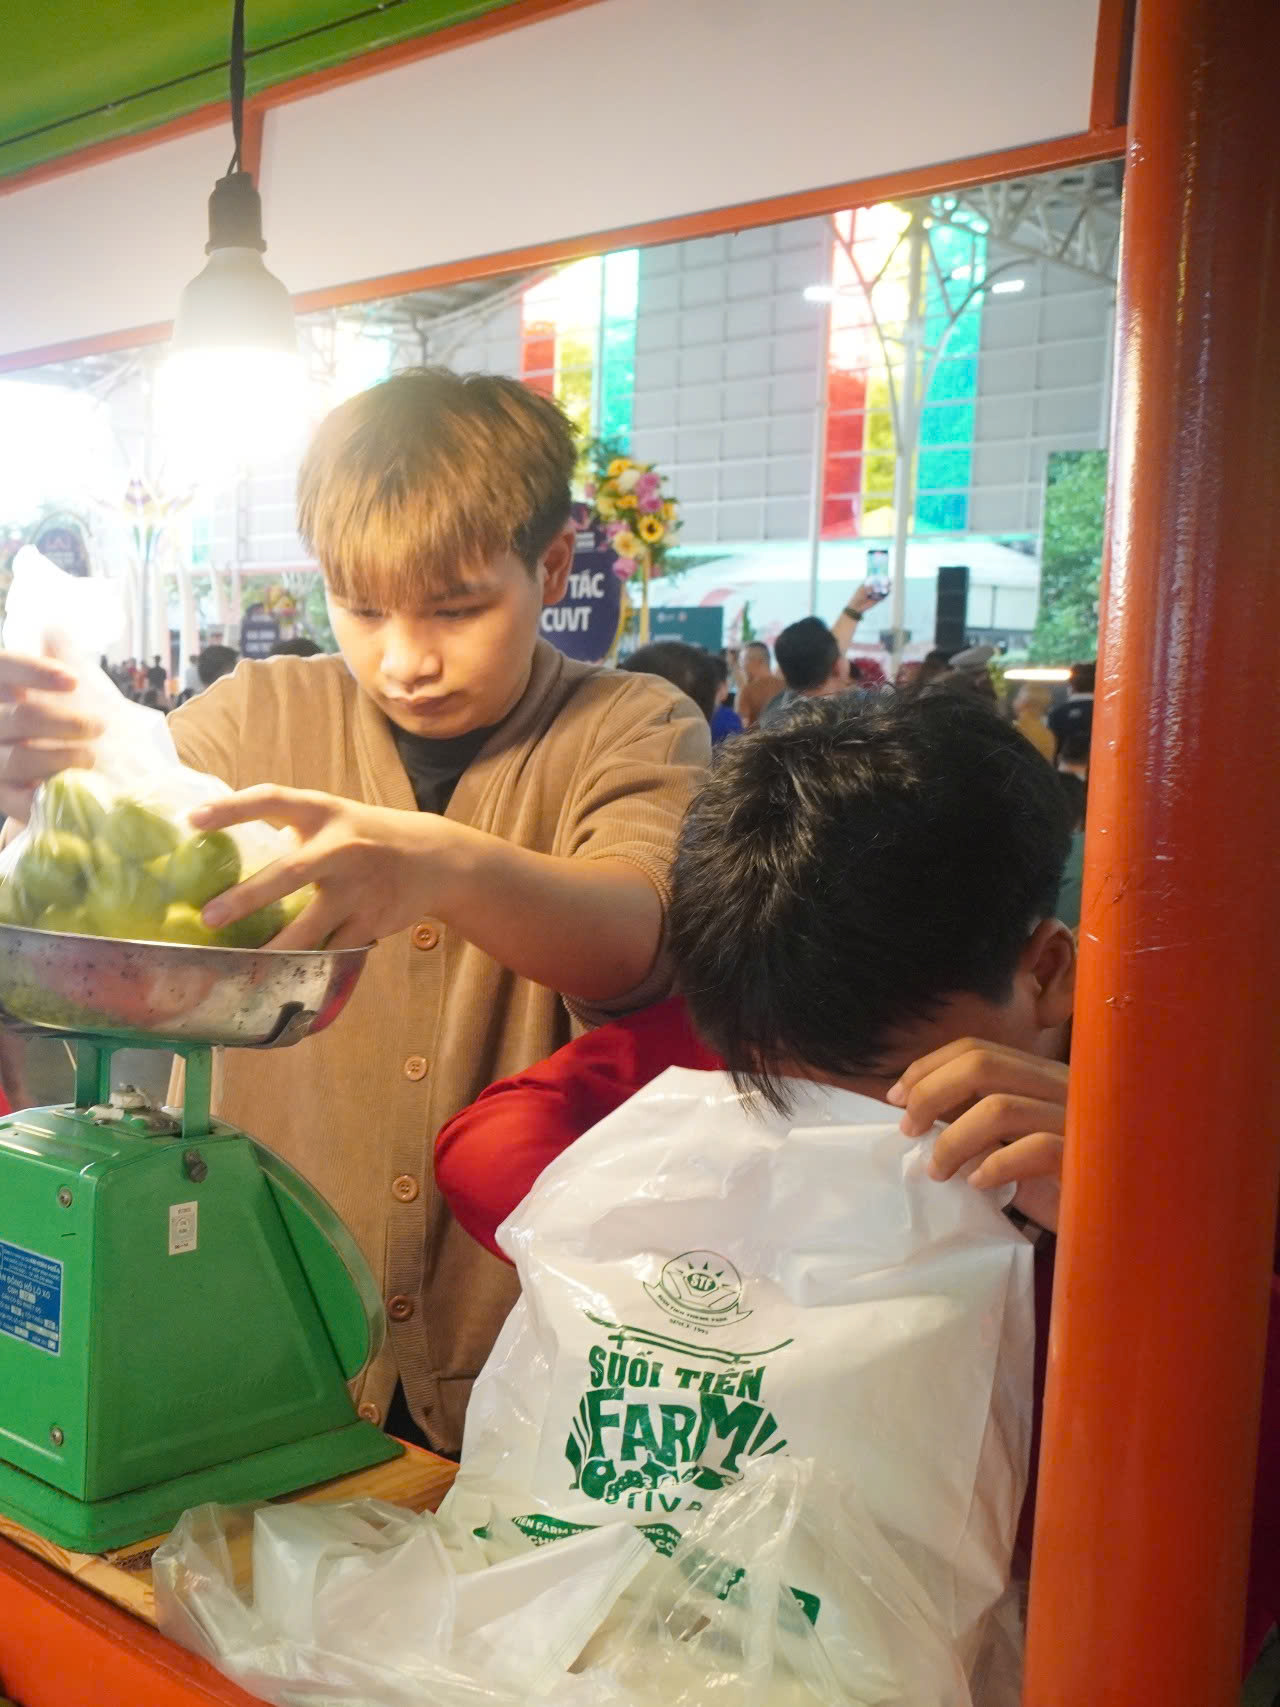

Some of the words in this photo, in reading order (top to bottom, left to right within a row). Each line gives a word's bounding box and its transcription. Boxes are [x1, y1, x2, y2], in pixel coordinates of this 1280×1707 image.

[568, 569, 605, 599] TÁC
[541, 606, 592, 632] CUVT
[588, 1345, 663, 1388] SUỐI
[585, 1387, 764, 1474] FARM
[536, 1521, 569, 1534] FARM
